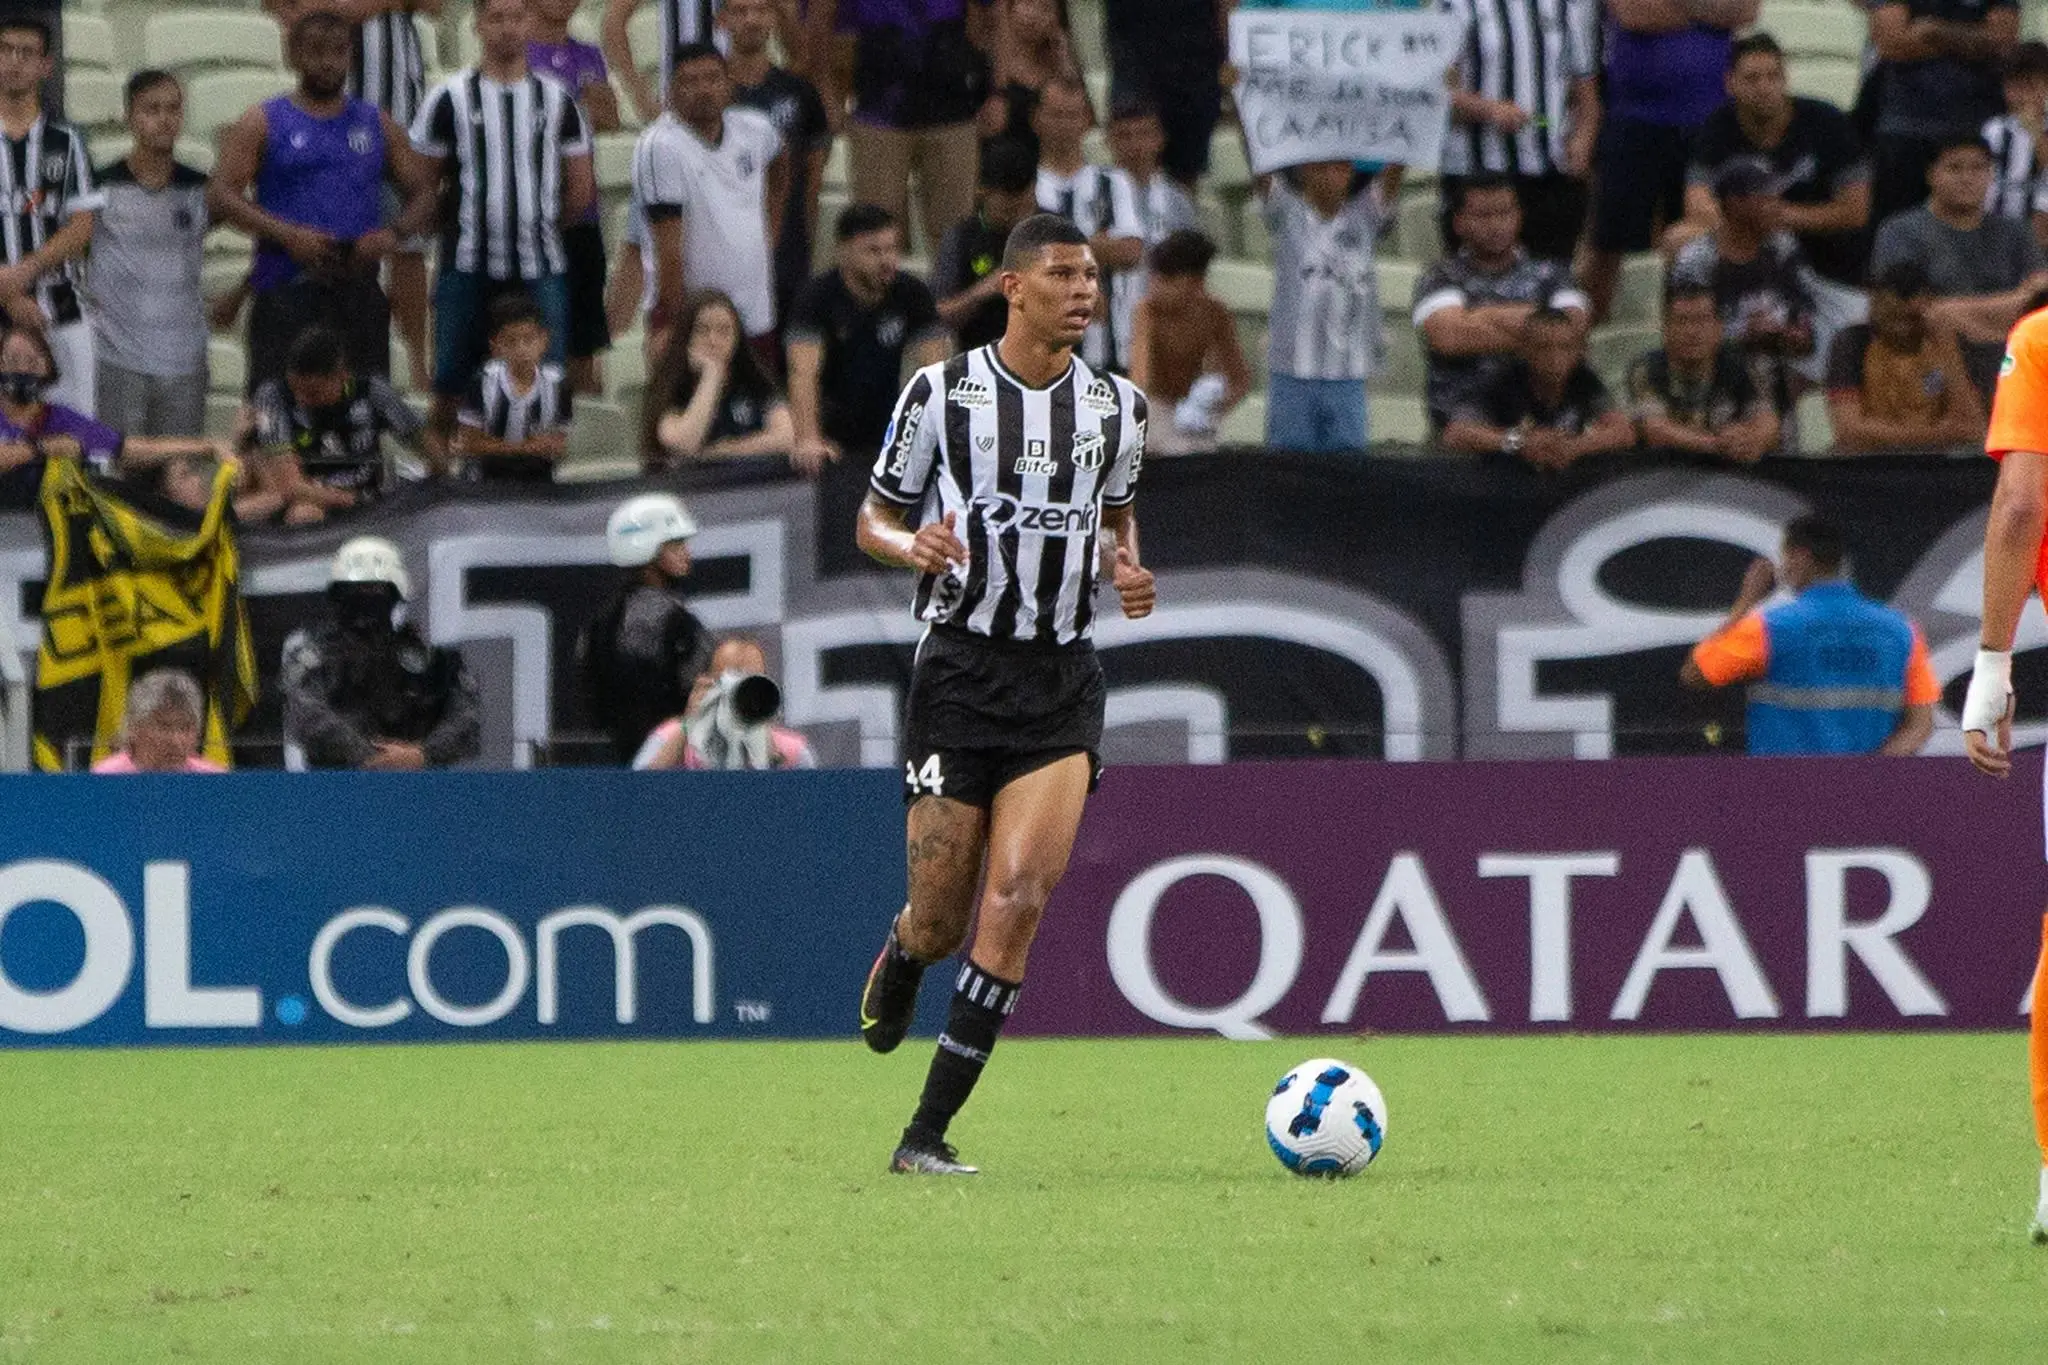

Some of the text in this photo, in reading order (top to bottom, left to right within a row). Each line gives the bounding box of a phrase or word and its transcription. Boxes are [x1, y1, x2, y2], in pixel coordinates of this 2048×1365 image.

[1246, 24, 1384, 72] ERICK
[888, 402, 923, 478] betcris
[1015, 460, 1057, 476] Bitci
[0, 858, 714, 1033] OL.com
[1106, 846, 1951, 1040] QATAR
